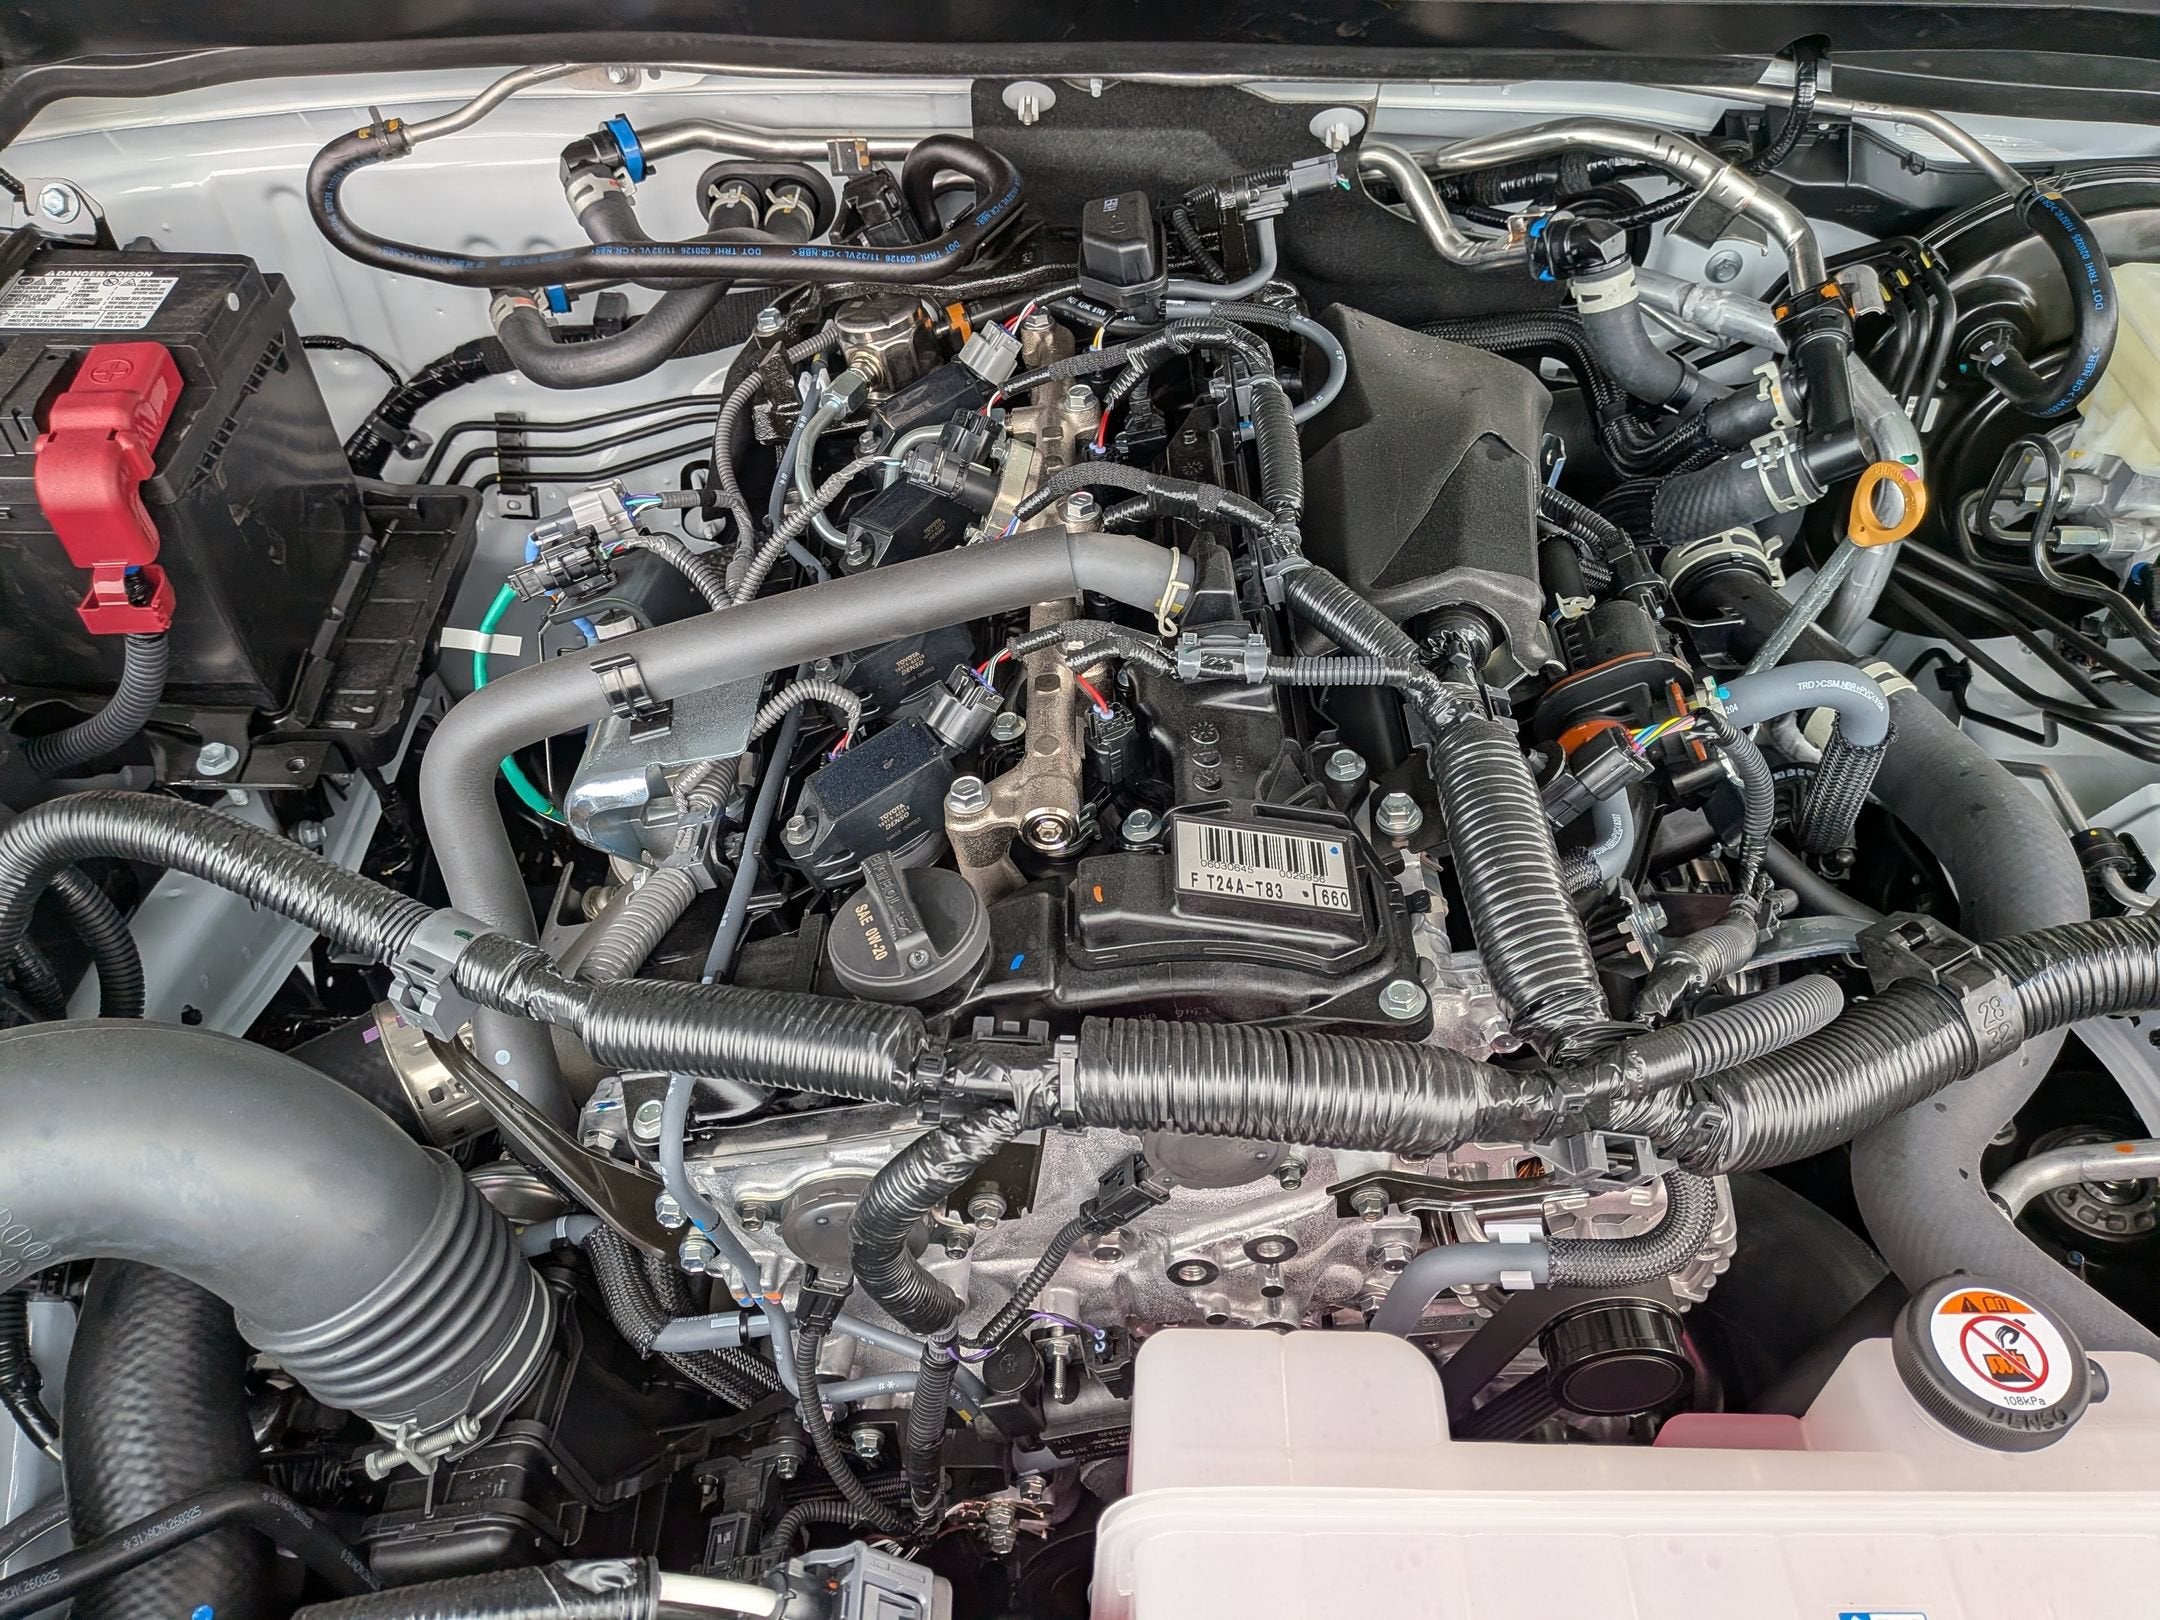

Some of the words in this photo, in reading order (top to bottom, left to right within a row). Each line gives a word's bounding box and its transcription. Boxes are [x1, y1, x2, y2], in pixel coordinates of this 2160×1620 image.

[742, 247, 762, 256] DOT
[944, 240, 961, 254] DOT
[2092, 289, 2104, 311] DOT
[895, 651, 921, 667] TOYOTA
[901, 660, 924, 676] DENSO
[879, 803, 906, 821] TOYOTA
[885, 811, 910, 830] DENSO
[1200, 859, 1254, 874] 06030645
[1279, 870, 1326, 884] 0029956
[1190, 872, 1199, 888] F
[1206, 874, 1284, 899] T24A-T83
[1321, 889, 1349, 908] 660
[854, 903, 874, 927] SAE
[864, 927, 889, 961] 0W-20
[1978, 995, 2005, 1030] 28
[2003, 1395, 2047, 1407] 108kPa
[1987, 1406, 2068, 1431] DENSO
